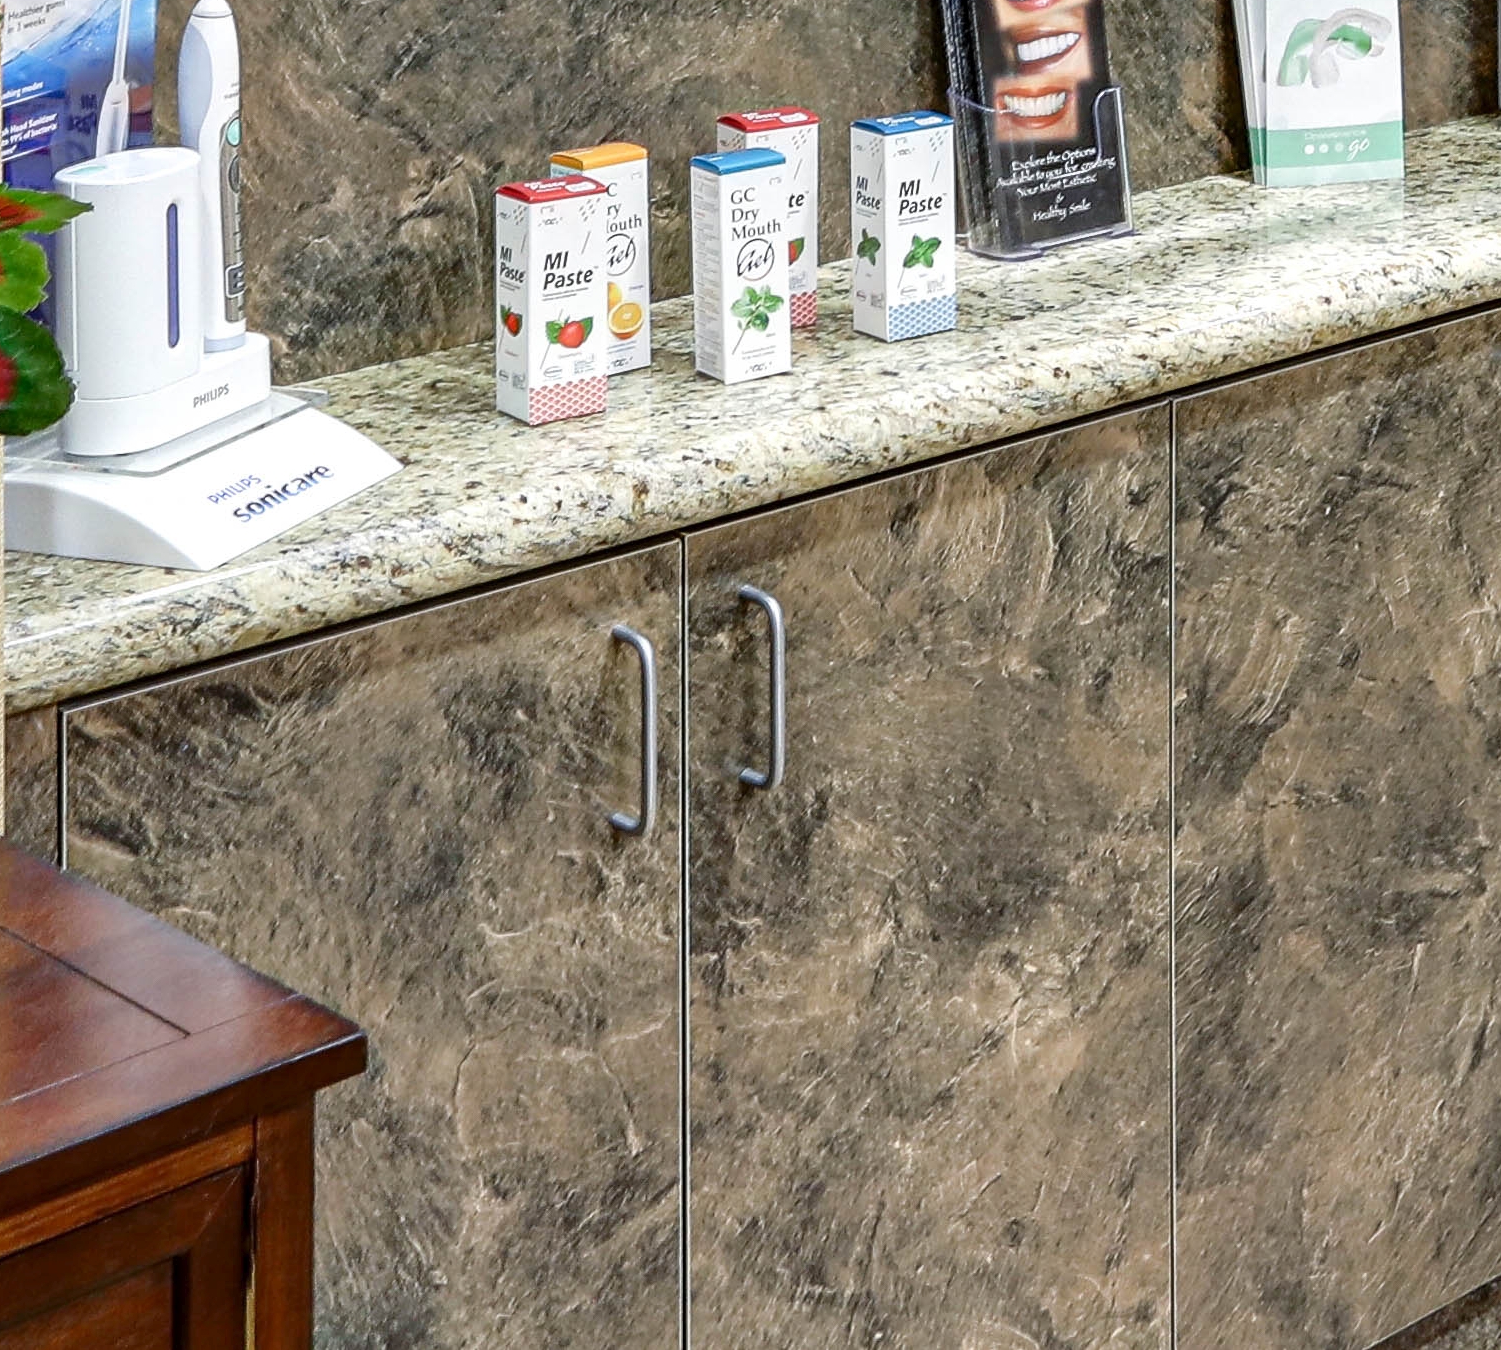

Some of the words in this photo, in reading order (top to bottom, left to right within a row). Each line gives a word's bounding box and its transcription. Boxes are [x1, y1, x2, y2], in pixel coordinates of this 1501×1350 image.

[1346, 137, 1370, 161] go
[856, 176, 869, 192] MI
[899, 178, 920, 199] MI
[730, 187, 756, 205] GC
[856, 191, 881, 211] Paste
[899, 193, 943, 216] Paste
[607, 203, 622, 219] ry
[731, 208, 760, 225] Dry
[606, 213, 642, 233] outh
[731, 219, 782, 241] Mouth
[499, 245, 512, 262] MI
[543, 251, 569, 271] MI
[499, 262, 525, 283] Paste
[543, 268, 594, 290] Paste
[192, 384, 230, 408] PHILIPS
[207, 474, 262, 505] PHILIPS
[232, 463, 334, 523] sonicare
